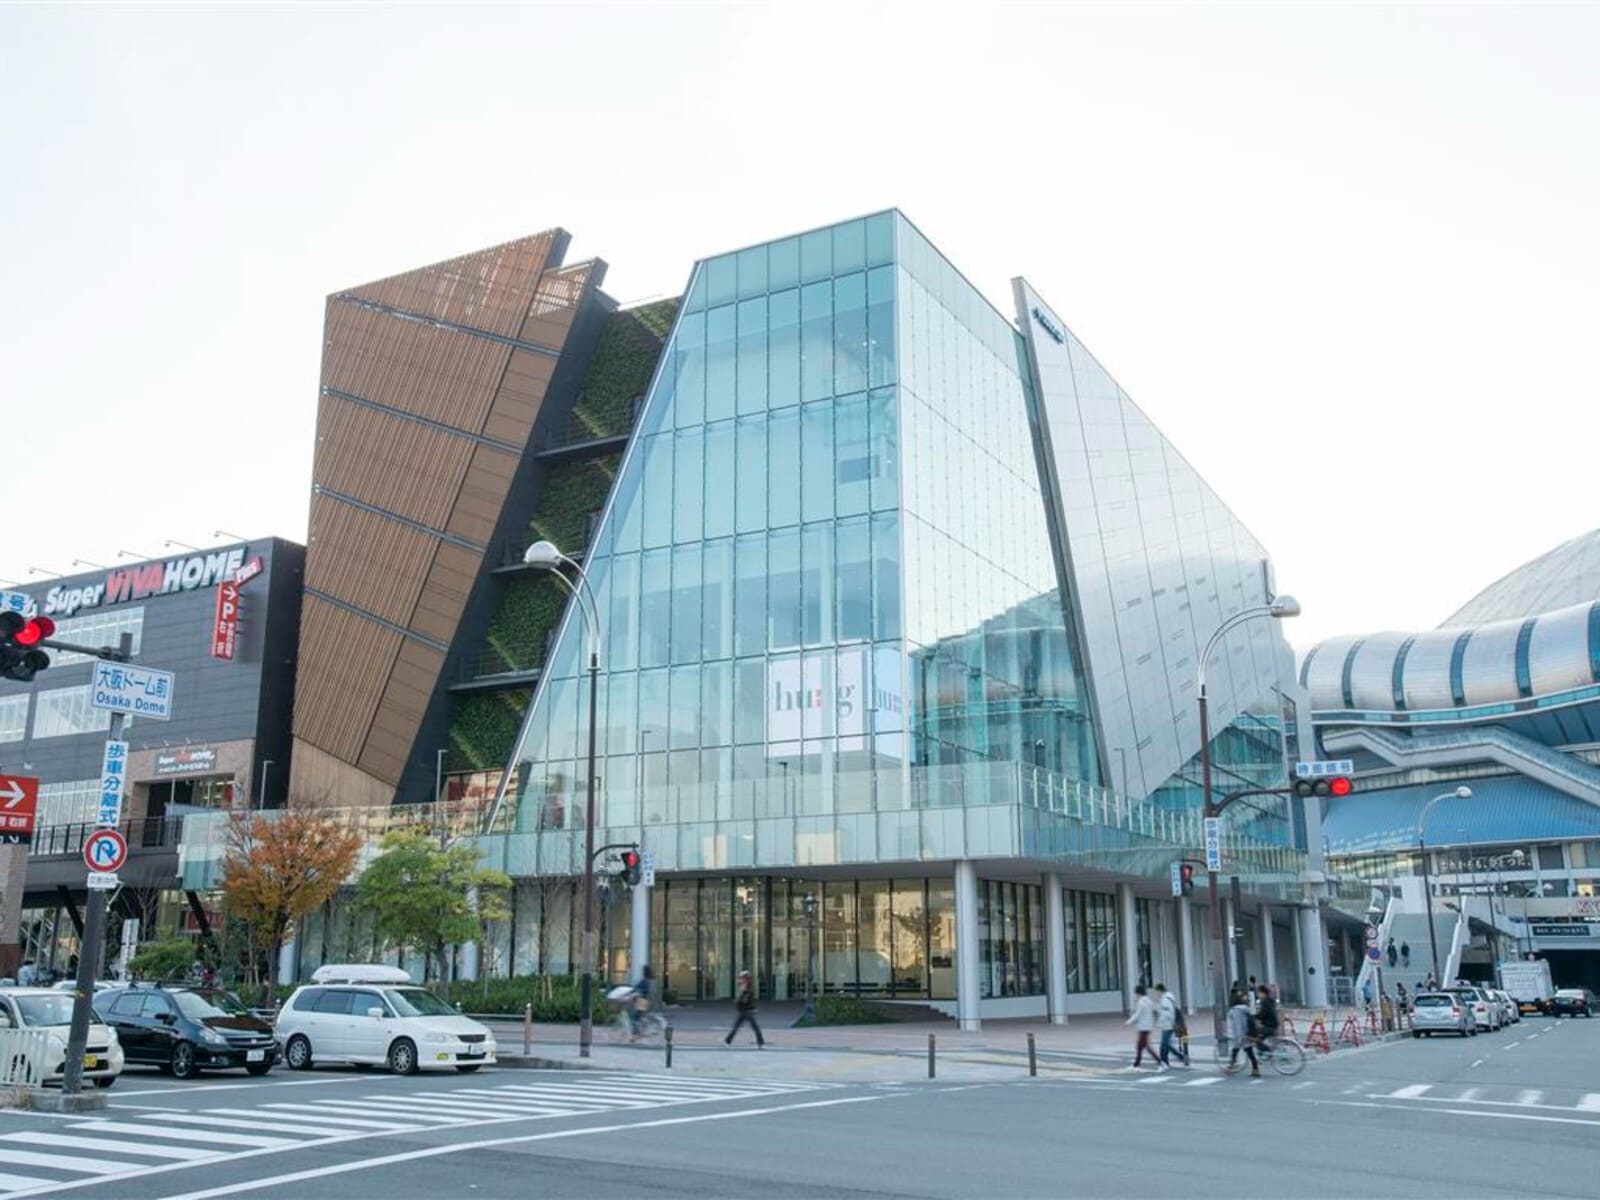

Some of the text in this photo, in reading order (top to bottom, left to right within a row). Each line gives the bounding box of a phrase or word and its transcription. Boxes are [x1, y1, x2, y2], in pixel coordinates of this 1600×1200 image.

[0, 592, 25, 611] 号
[45, 584, 105, 615] Super
[98, 668, 168, 698] 大阪ドーム前
[97, 691, 165, 712] Osaka Dome
[99, 744, 125, 824] 歩車分離式
